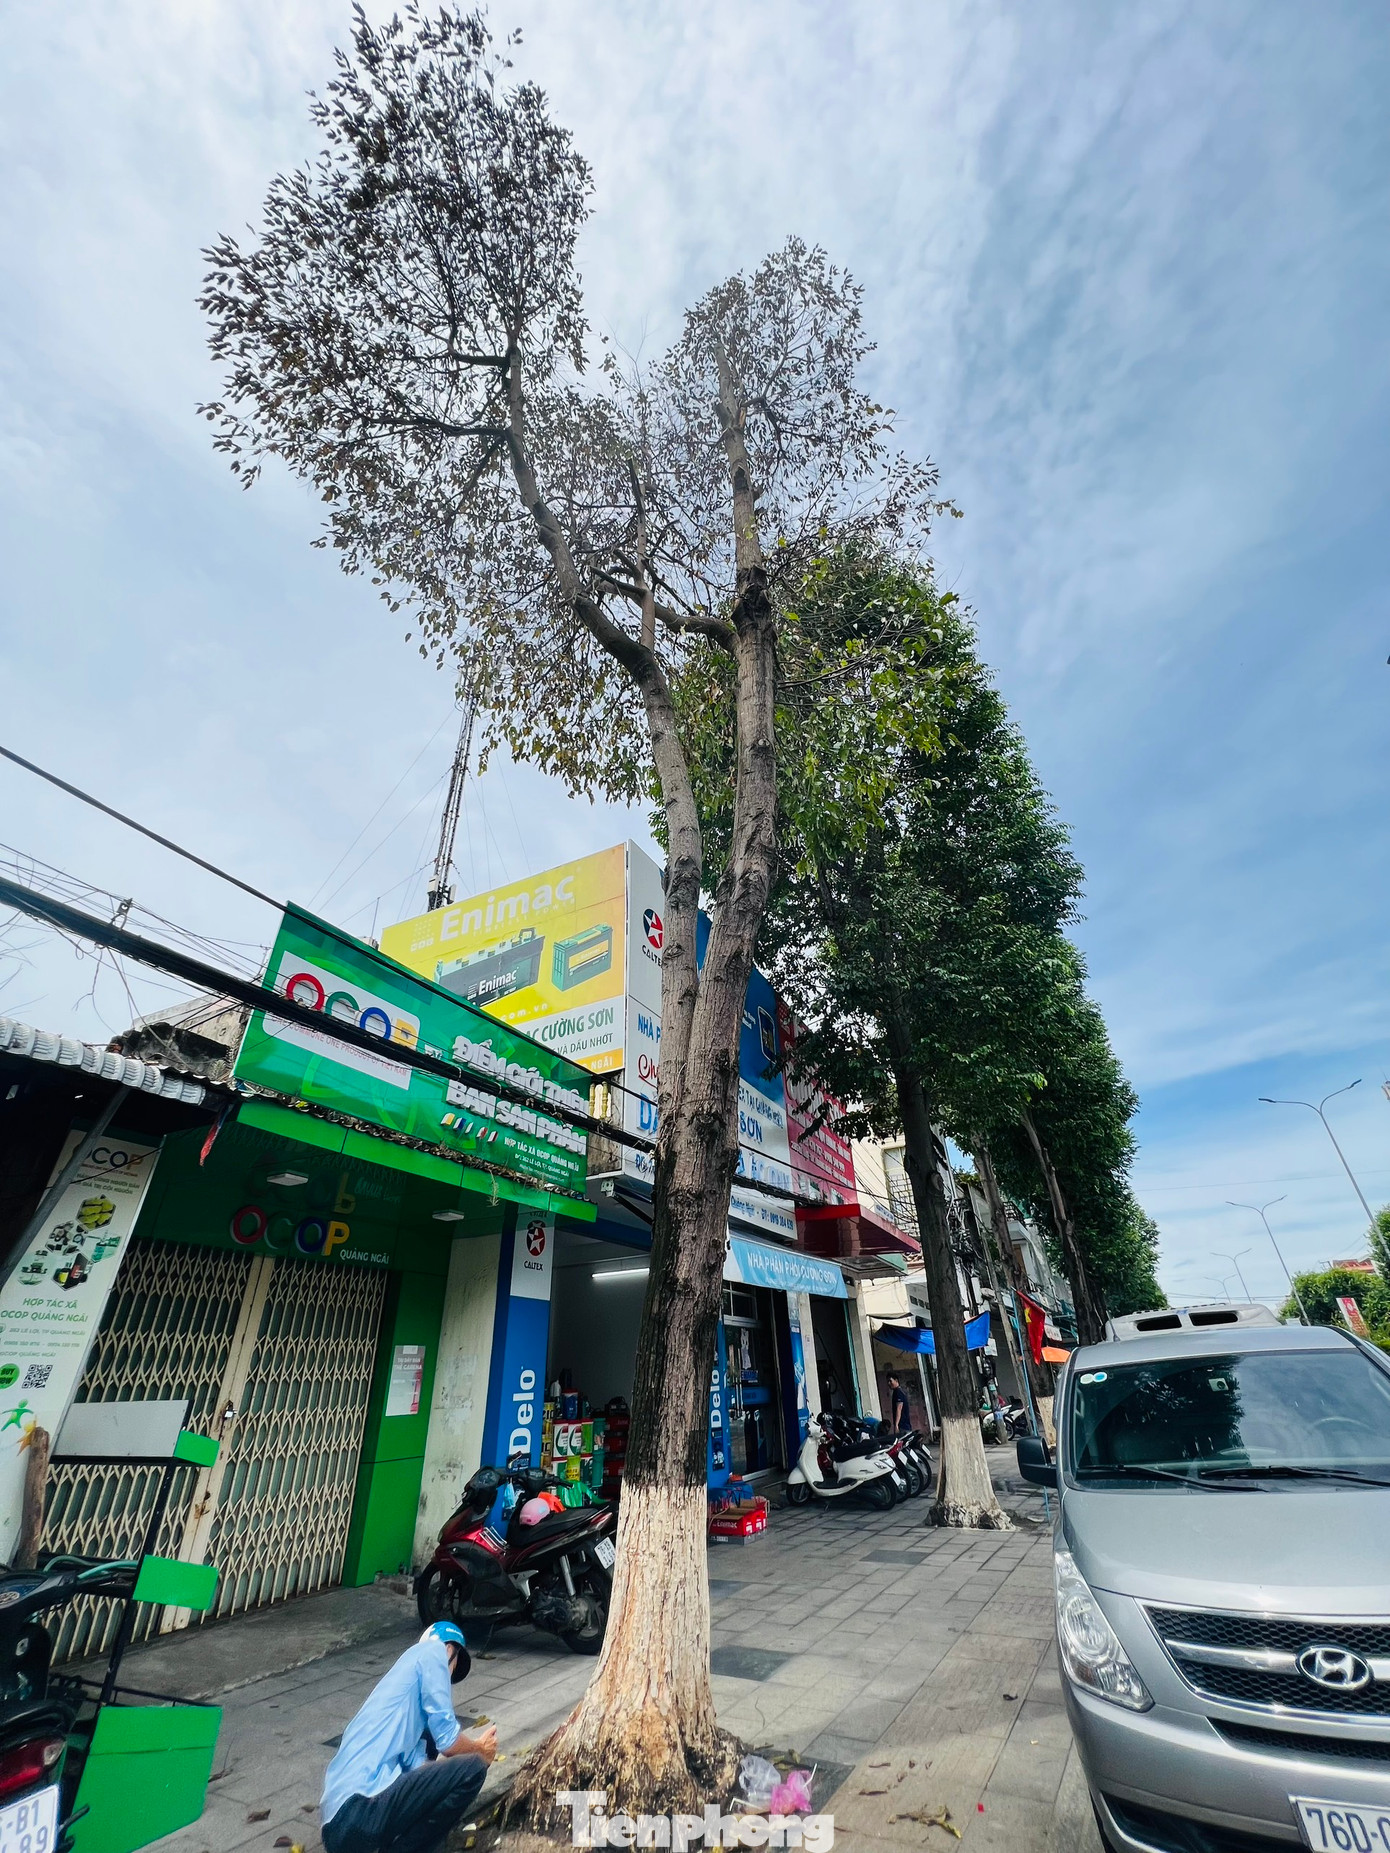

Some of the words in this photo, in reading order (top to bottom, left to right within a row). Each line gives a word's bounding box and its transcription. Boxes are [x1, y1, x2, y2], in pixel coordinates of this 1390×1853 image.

[440, 875, 575, 942] Enimac
[641, 944, 661, 967] CALTE
[478, 968, 517, 996] Enimac
[285, 972, 418, 1048] OCOP
[541, 1014, 585, 1042] CƯỜNG
[587, 1006, 614, 1030] SƠN
[638, 1012, 654, 1041] NHÀ
[326, 1034, 340, 1049] ONE
[557, 1043, 569, 1056] VÀ
[517, 1141, 528, 1152] TÁC
[536, 1149, 551, 1160] OCOP
[230, 1204, 350, 1256] OCOP
[340, 1247, 369, 1261] QUẢNG
[370, 1250, 389, 1264] NGÃI
[524, 1260, 544, 1271] CALTEX
[0, 1310, 29, 1319] OCOP
[30, 1309, 65, 1321] QUẢNG
[66, 1312, 88, 1323] NGÃI
[46, 1298, 63, 1308] TÁC
[65, 1299, 78, 1309] XÃ
[508, 1369, 536, 1455] Delo
[710, 1369, 723, 1428] Delo
[0, 1799, 39, 1835] -B1
